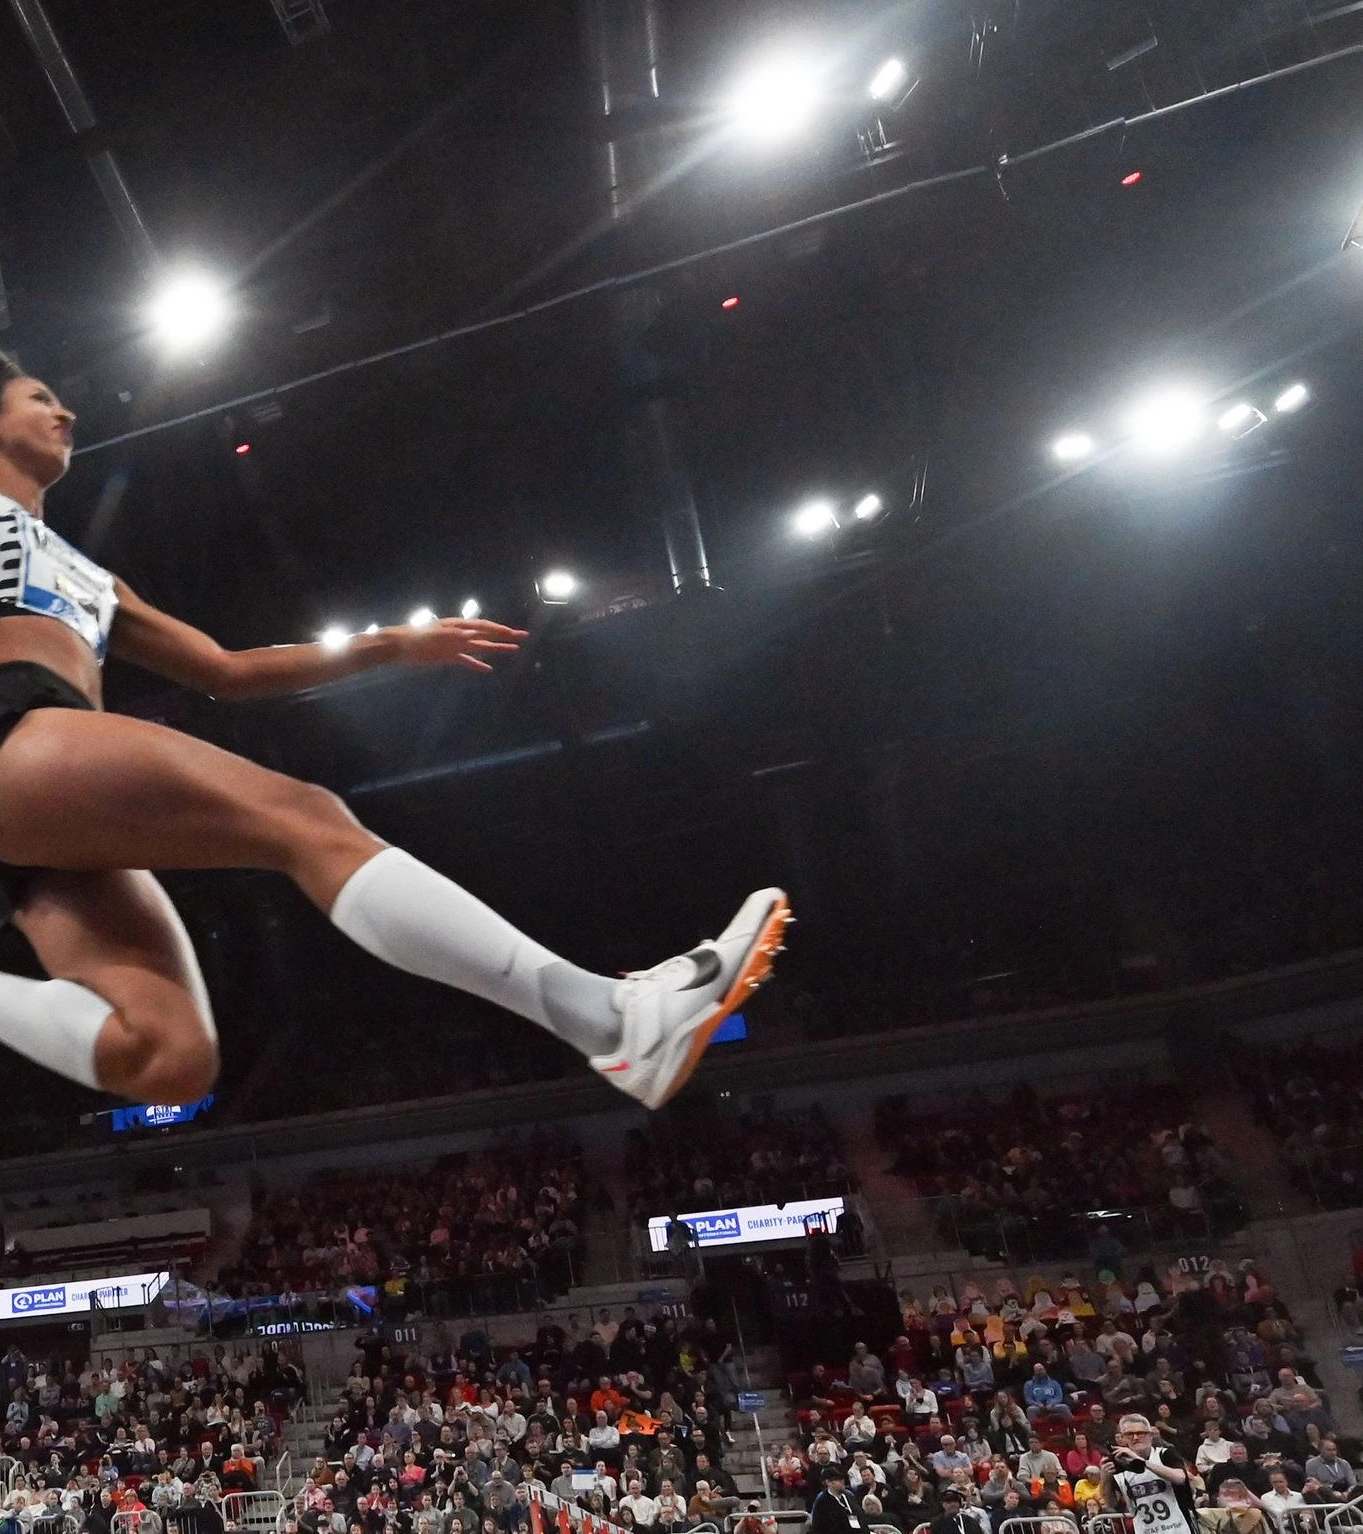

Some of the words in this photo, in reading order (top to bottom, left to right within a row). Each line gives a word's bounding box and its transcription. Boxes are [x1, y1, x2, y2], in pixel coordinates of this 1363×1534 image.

[696, 1217, 737, 1233] PLAN
[1177, 1255, 1212, 1273] 012
[33, 1290, 64, 1304] PLAN
[395, 1327, 416, 1343] 011
[1137, 1499, 1171, 1525] 39
